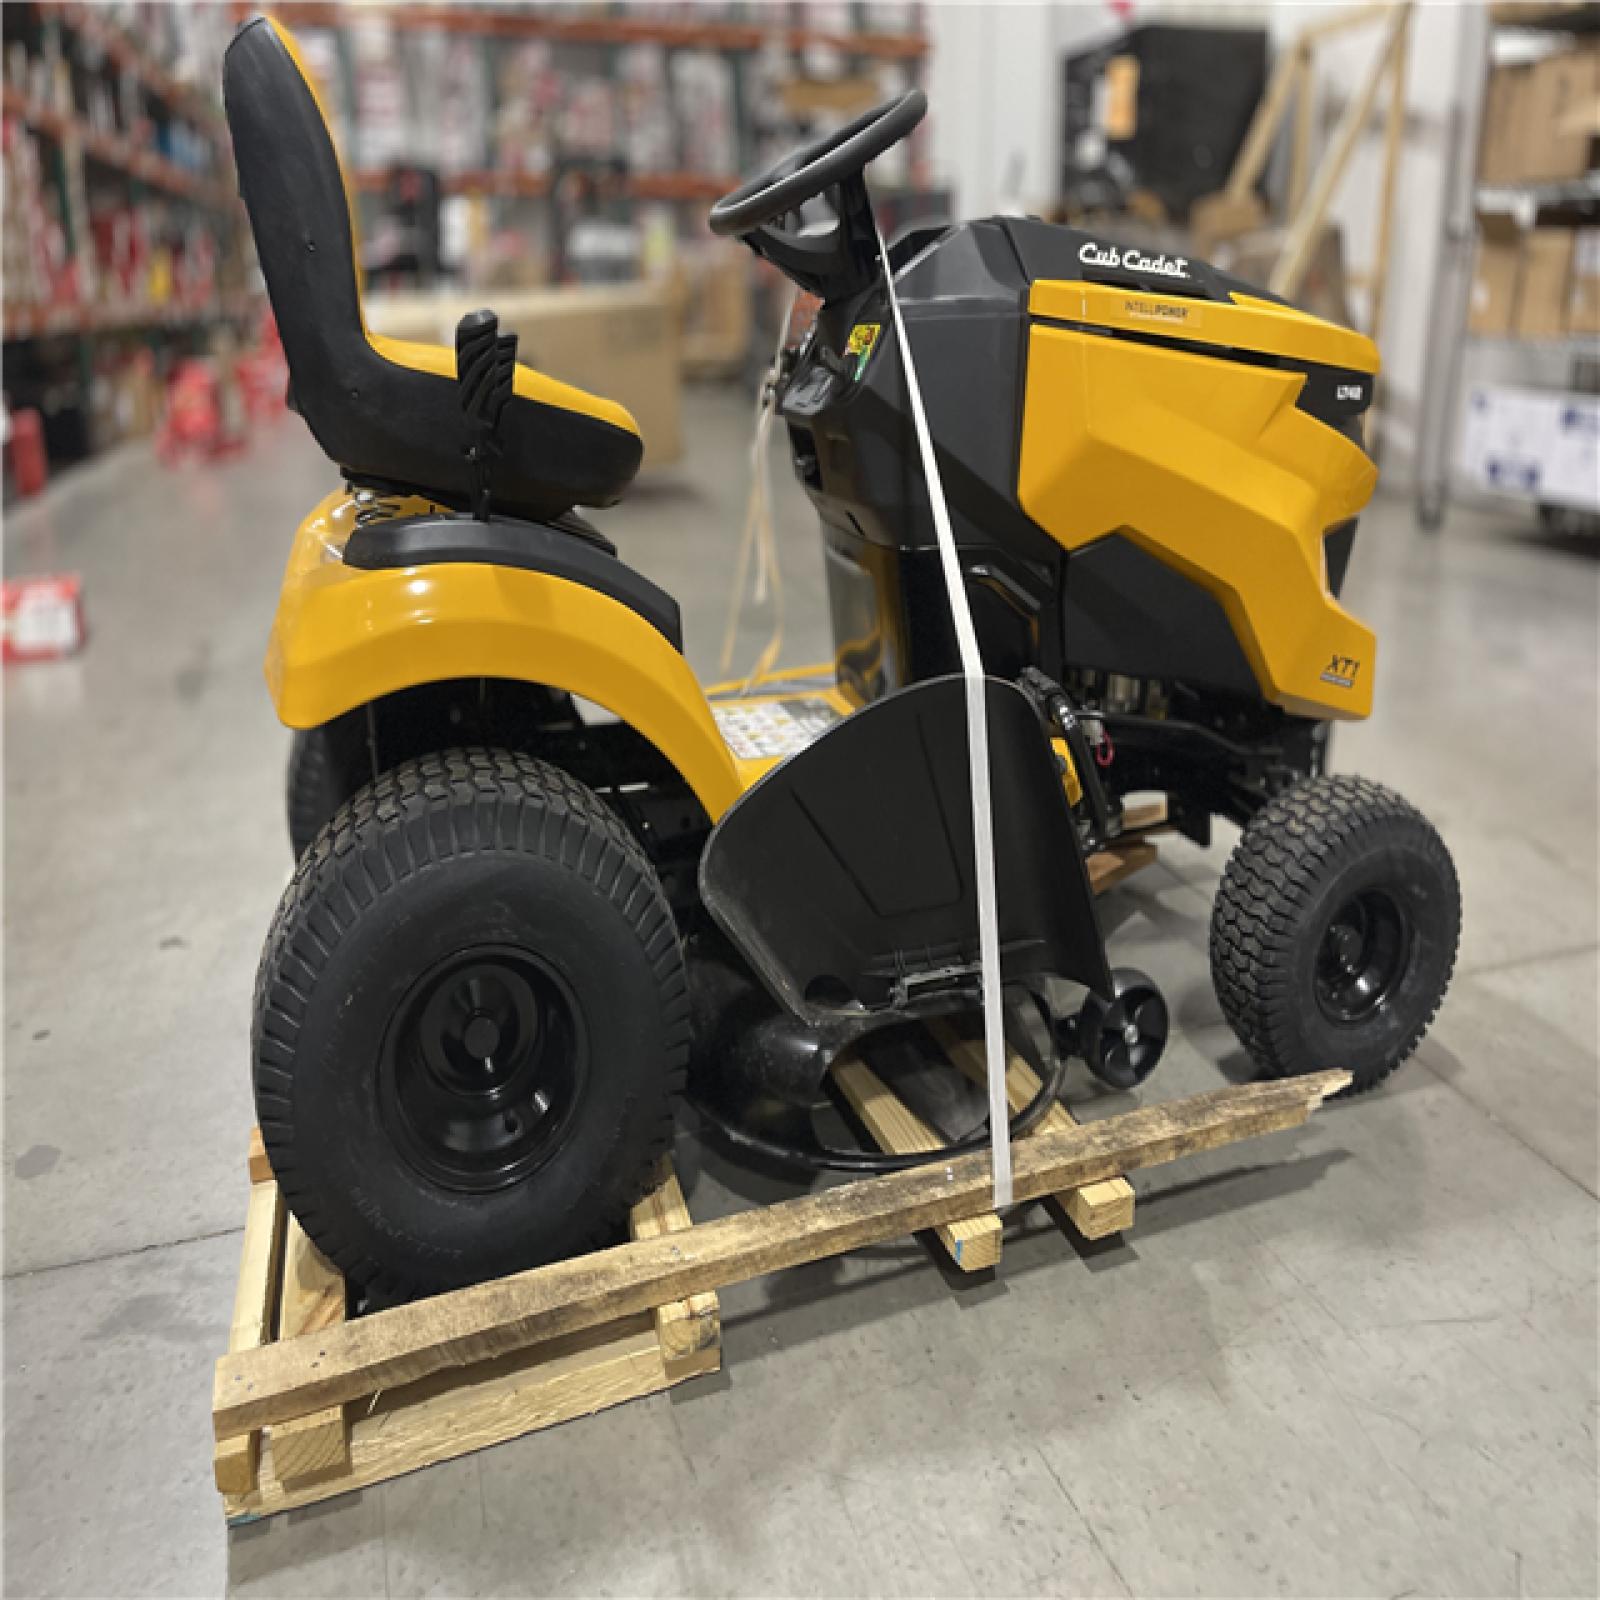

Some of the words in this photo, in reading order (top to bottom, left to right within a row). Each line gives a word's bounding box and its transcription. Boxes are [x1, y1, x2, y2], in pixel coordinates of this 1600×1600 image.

[1078, 241, 1121, 268] Cub
[1122, 249, 1189, 279] Cadet
[1326, 654, 1361, 677] XT1
